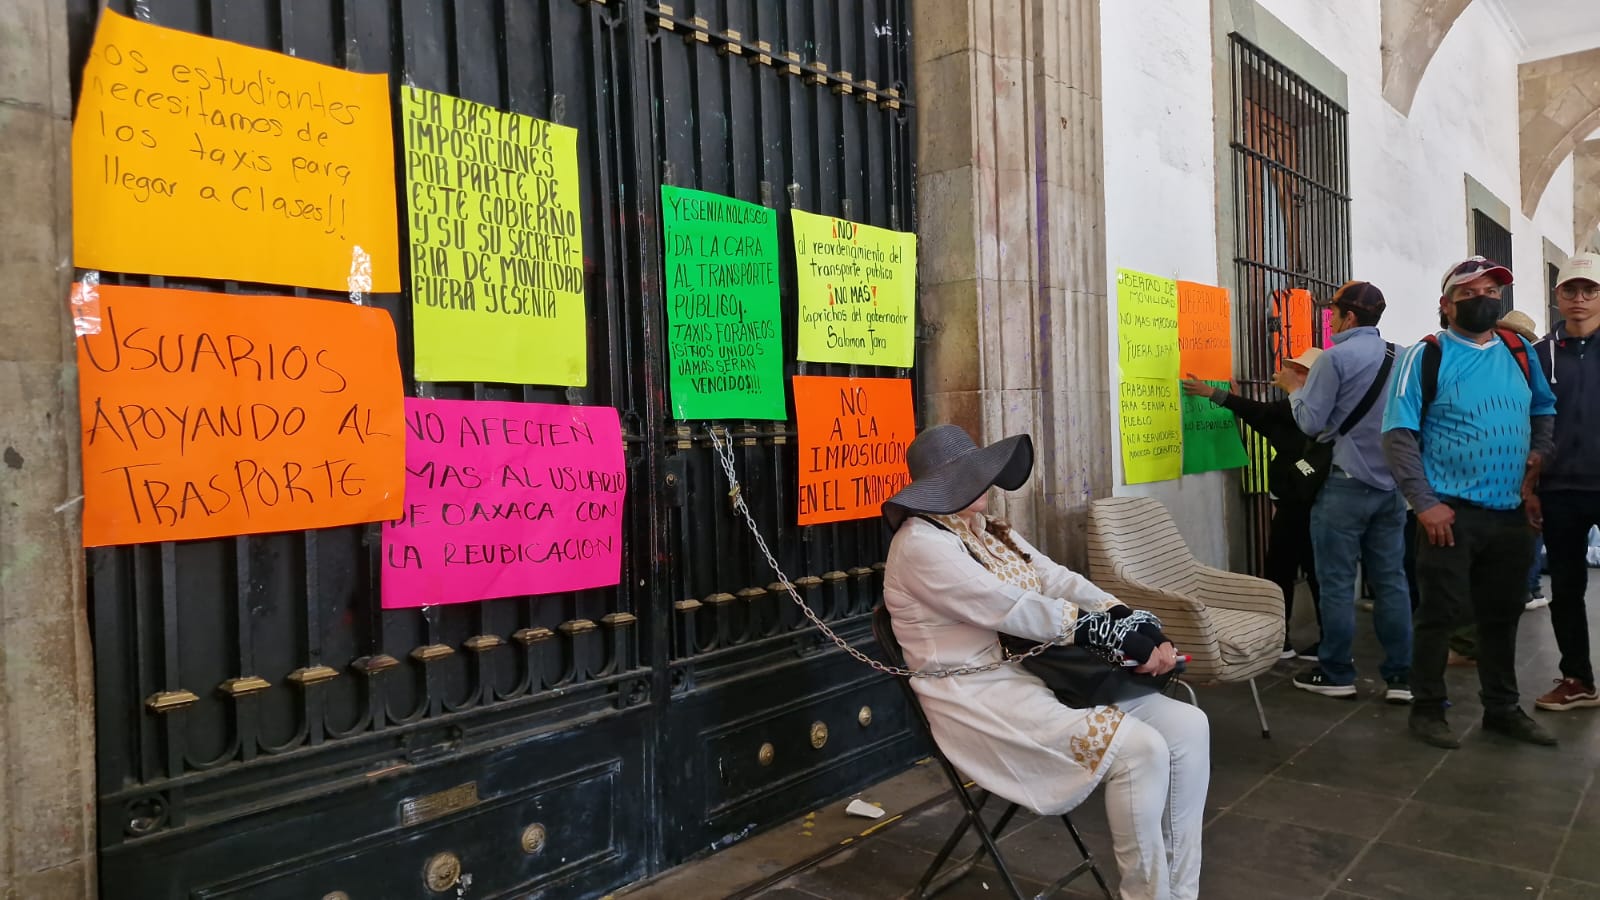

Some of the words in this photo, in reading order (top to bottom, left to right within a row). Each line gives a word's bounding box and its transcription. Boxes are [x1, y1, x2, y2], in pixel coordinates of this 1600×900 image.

[93, 44, 148, 74] os
[172, 56, 361, 125] estudiantes
[92, 75, 283, 138] necesitamos
[297, 122, 328, 148] de
[410, 87, 442, 121] YA
[452, 98, 520, 144] BASTA
[529, 118, 553, 152] DE
[100, 110, 157, 149] los
[189, 132, 273, 173] taxis
[291, 155, 351, 186] para
[408, 118, 555, 179] IMPOSICIONES
[104, 154, 177, 203] llegar
[199, 185, 221, 203] a
[408, 150, 449, 187] POR
[456, 159, 528, 202] PARTE
[535, 175, 562, 209] DE
[412, 181, 469, 221] ESTE
[479, 193, 576, 237] GOBIERNO
[668, 196, 724, 223] YESENIA
[725, 204, 768, 225] NOLASCO
[414, 212, 429, 246] Y
[437, 216, 466, 250] SU
[477, 222, 502, 255] SU
[508, 228, 580, 266] SECRETA-
[700, 235, 718, 257] LA
[723, 236, 763, 257] CARA
[797, 233, 806, 255] al
[812, 239, 885, 263] reordenamiento
[889, 245, 902, 264] del
[412, 243, 449, 278] RIA
[462, 250, 492, 283] DE
[499, 255, 584, 295] MOVILIDAD
[674, 263, 693, 289] AL
[696, 262, 774, 288] TRANSPORTE
[809, 257, 861, 282] transporte
[866, 262, 893, 283] publico
[414, 275, 476, 312] FUERA
[484, 282, 557, 319] YESENIA
[1165, 281, 1175, 296] DE
[673, 323, 713, 343] TAXIS
[716, 319, 775, 345] FORANEOS
[802, 305, 847, 329] Caprichos
[851, 307, 862, 322] del
[866, 307, 908, 328] gobernador
[1119, 312, 1132, 326] NO
[1135, 315, 1151, 329] MAS
[78, 306, 347, 394] USUARIOS
[719, 342, 764, 361] UNIDOS
[826, 325, 866, 349] Salomon
[868, 328, 887, 356] Jara
[678, 358, 714, 377] JAMAS
[716, 357, 756, 374] SERAN
[840, 386, 868, 416] NO
[1121, 400, 1138, 413] PARA
[1169, 401, 1179, 412] AL
[86, 396, 306, 457] APOYANDO
[337, 403, 392, 444] AL
[404, 410, 445, 444] NO
[459, 416, 594, 448] AFECTEN
[829, 417, 843, 441] A
[857, 416, 879, 438] LA
[1123, 415, 1152, 429] PUEBLO
[809, 432, 906, 473] IMPOSICIÓN
[101, 459, 366, 527] TRASPORTE
[405, 461, 482, 490] MAS
[501, 464, 543, 488] AL
[549, 466, 625, 494] USUARIO
[441, 501, 554, 526] OAXACA
[575, 500, 617, 522] CON
[799, 482, 818, 515] EN
[823, 479, 846, 512] EL
[388, 543, 423, 569] LA
[444, 535, 612, 567] REUBICACION
